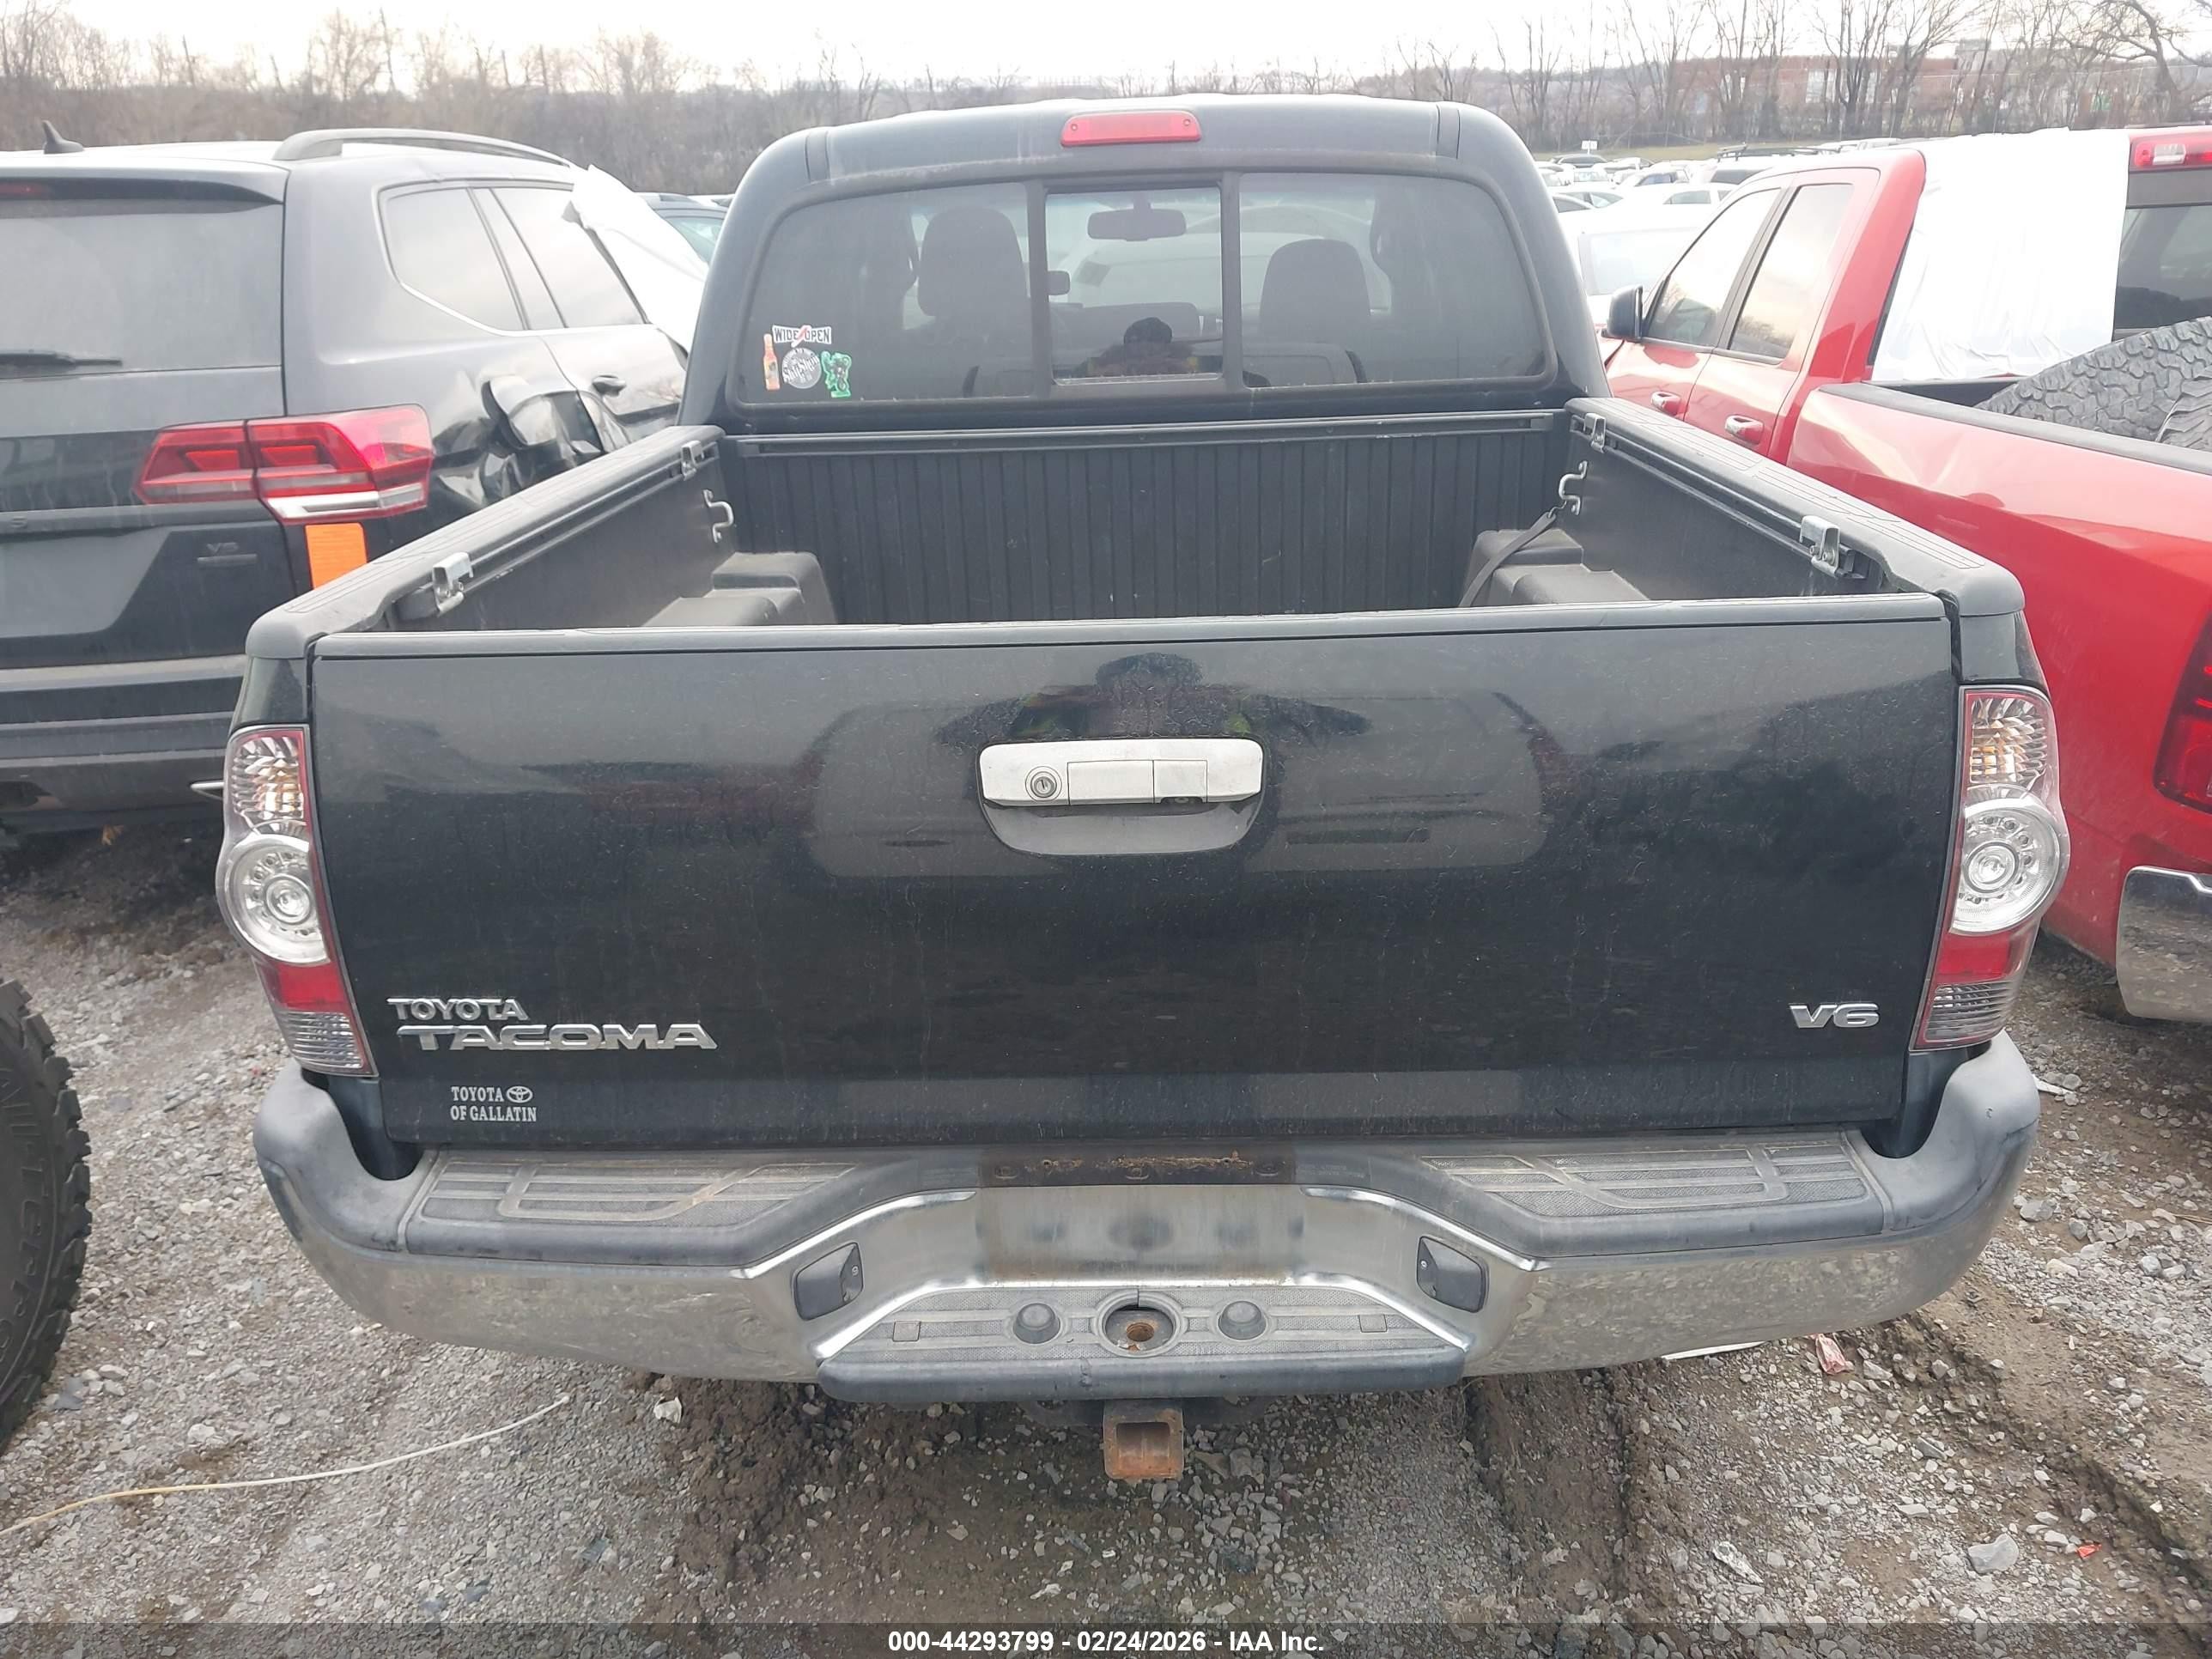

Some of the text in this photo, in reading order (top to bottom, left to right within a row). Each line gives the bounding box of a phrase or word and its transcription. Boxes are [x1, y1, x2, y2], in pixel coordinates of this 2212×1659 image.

[774, 327, 830, 343] WIDE OPEN
[386, 998, 529, 1021] TOYOTA
[1789, 1003, 1879, 1029] V6
[397, 1024, 718, 1051] TACOMA
[451, 1086, 504, 1103] TOYOTA
[450, 1105, 537, 1122] OF GALLATIN
